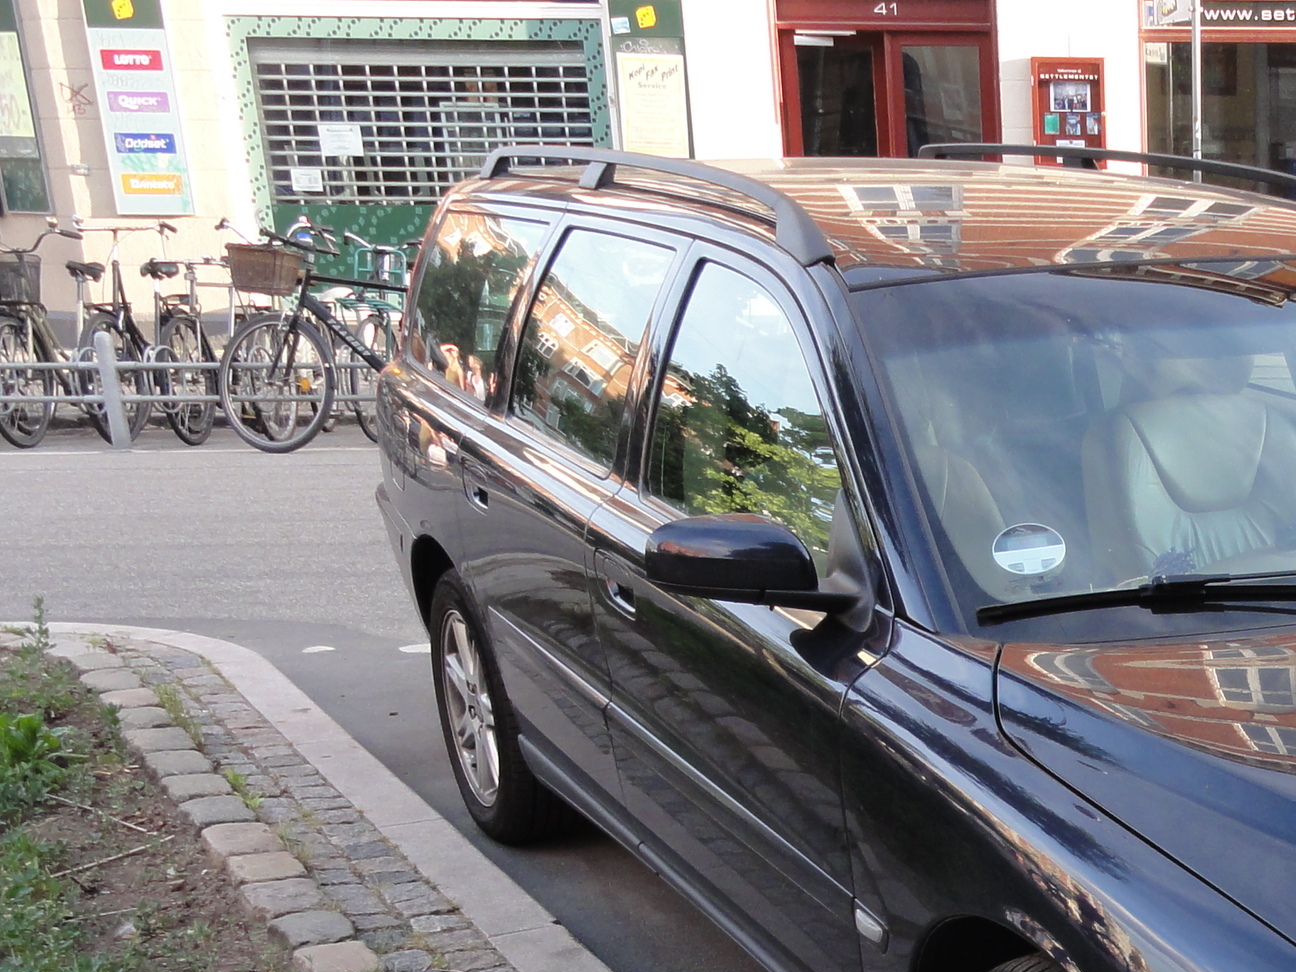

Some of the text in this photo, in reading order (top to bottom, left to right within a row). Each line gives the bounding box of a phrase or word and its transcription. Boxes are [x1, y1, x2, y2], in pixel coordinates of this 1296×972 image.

[873, 2, 897, 16] 41
[113, 54, 150, 65] LOTTO
[125, 138, 167, 149] Oddset
